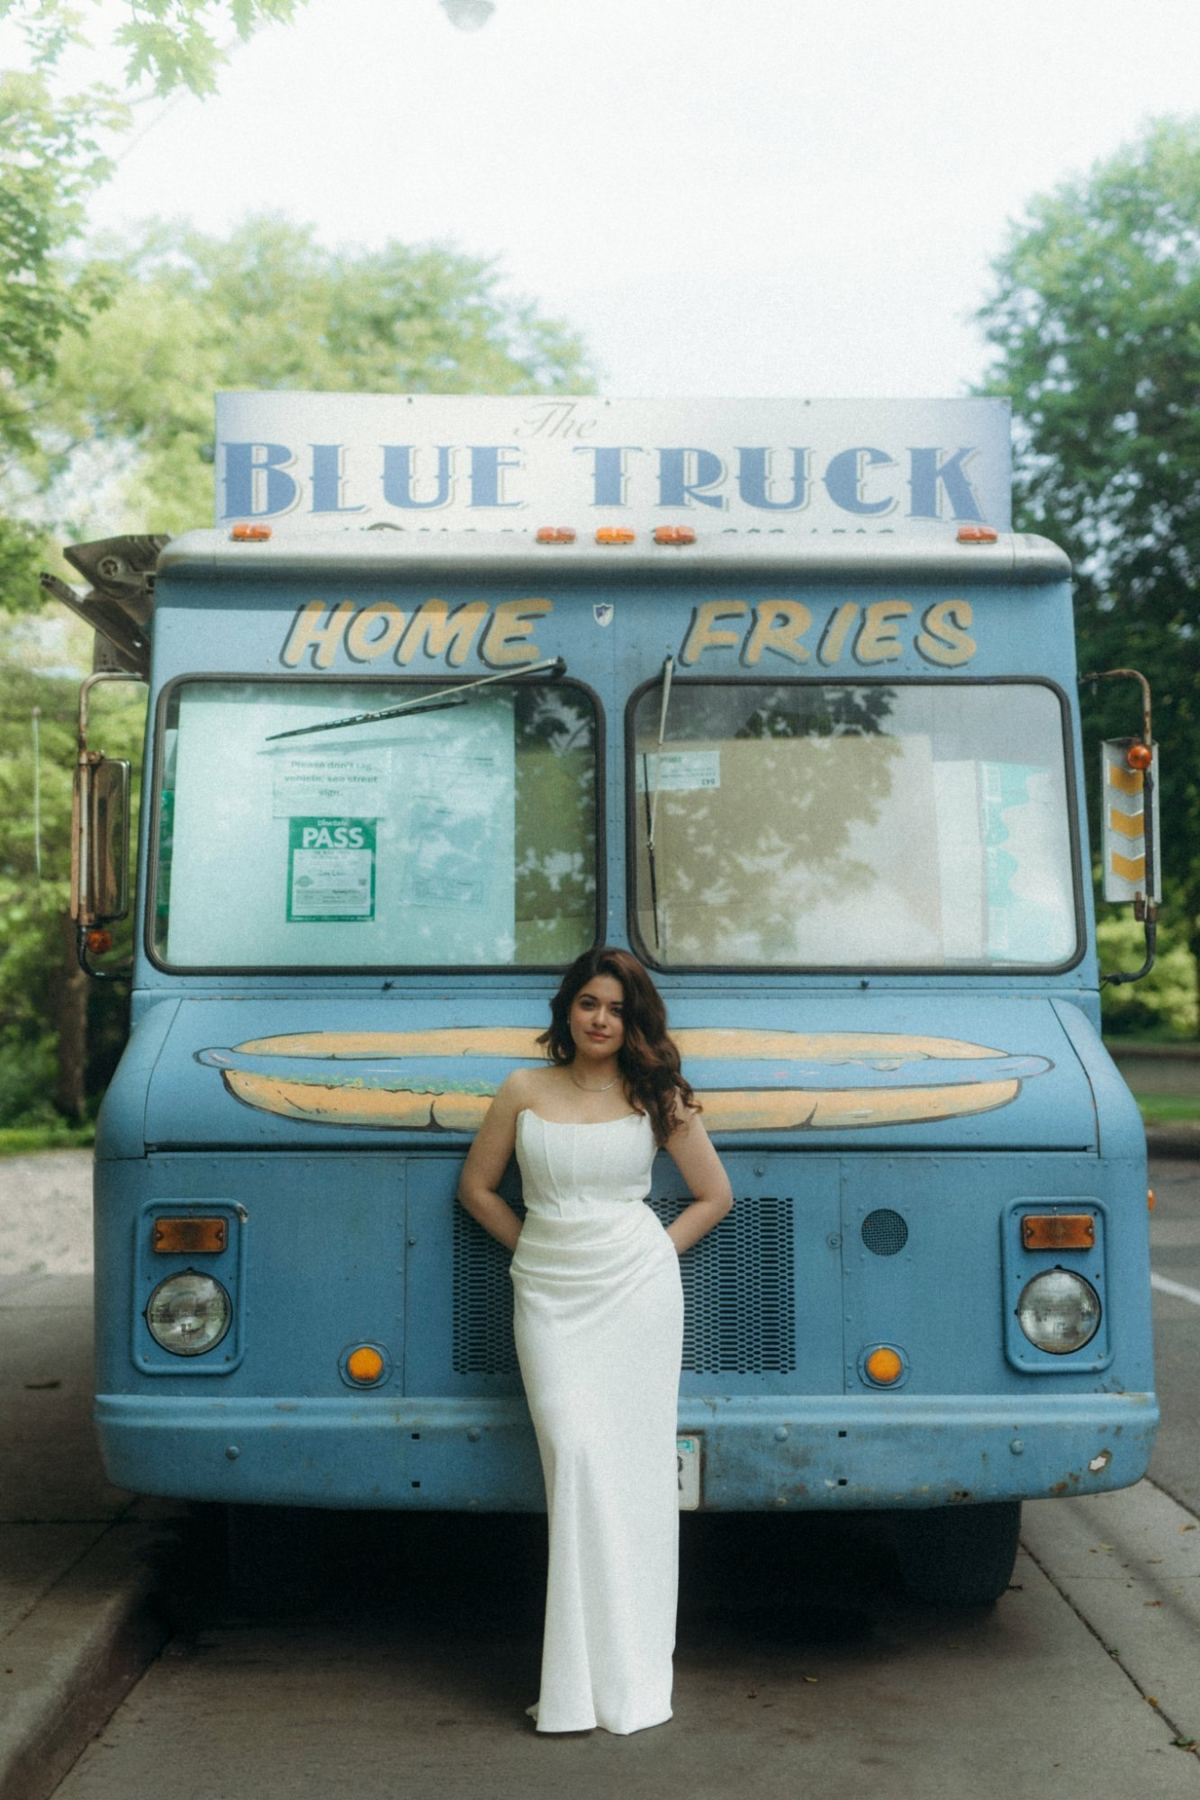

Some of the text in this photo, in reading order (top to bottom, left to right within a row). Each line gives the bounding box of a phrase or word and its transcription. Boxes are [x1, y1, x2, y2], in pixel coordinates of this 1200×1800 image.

[513, 402, 598, 438] The
[221, 442, 989, 523] BLUE TRUCK
[280, 598, 978, 670] HOME FRIES
[290, 760, 325, 769] Please
[327, 760, 354, 769] don't
[347, 774, 378, 783] street
[302, 827, 364, 849] PASS
